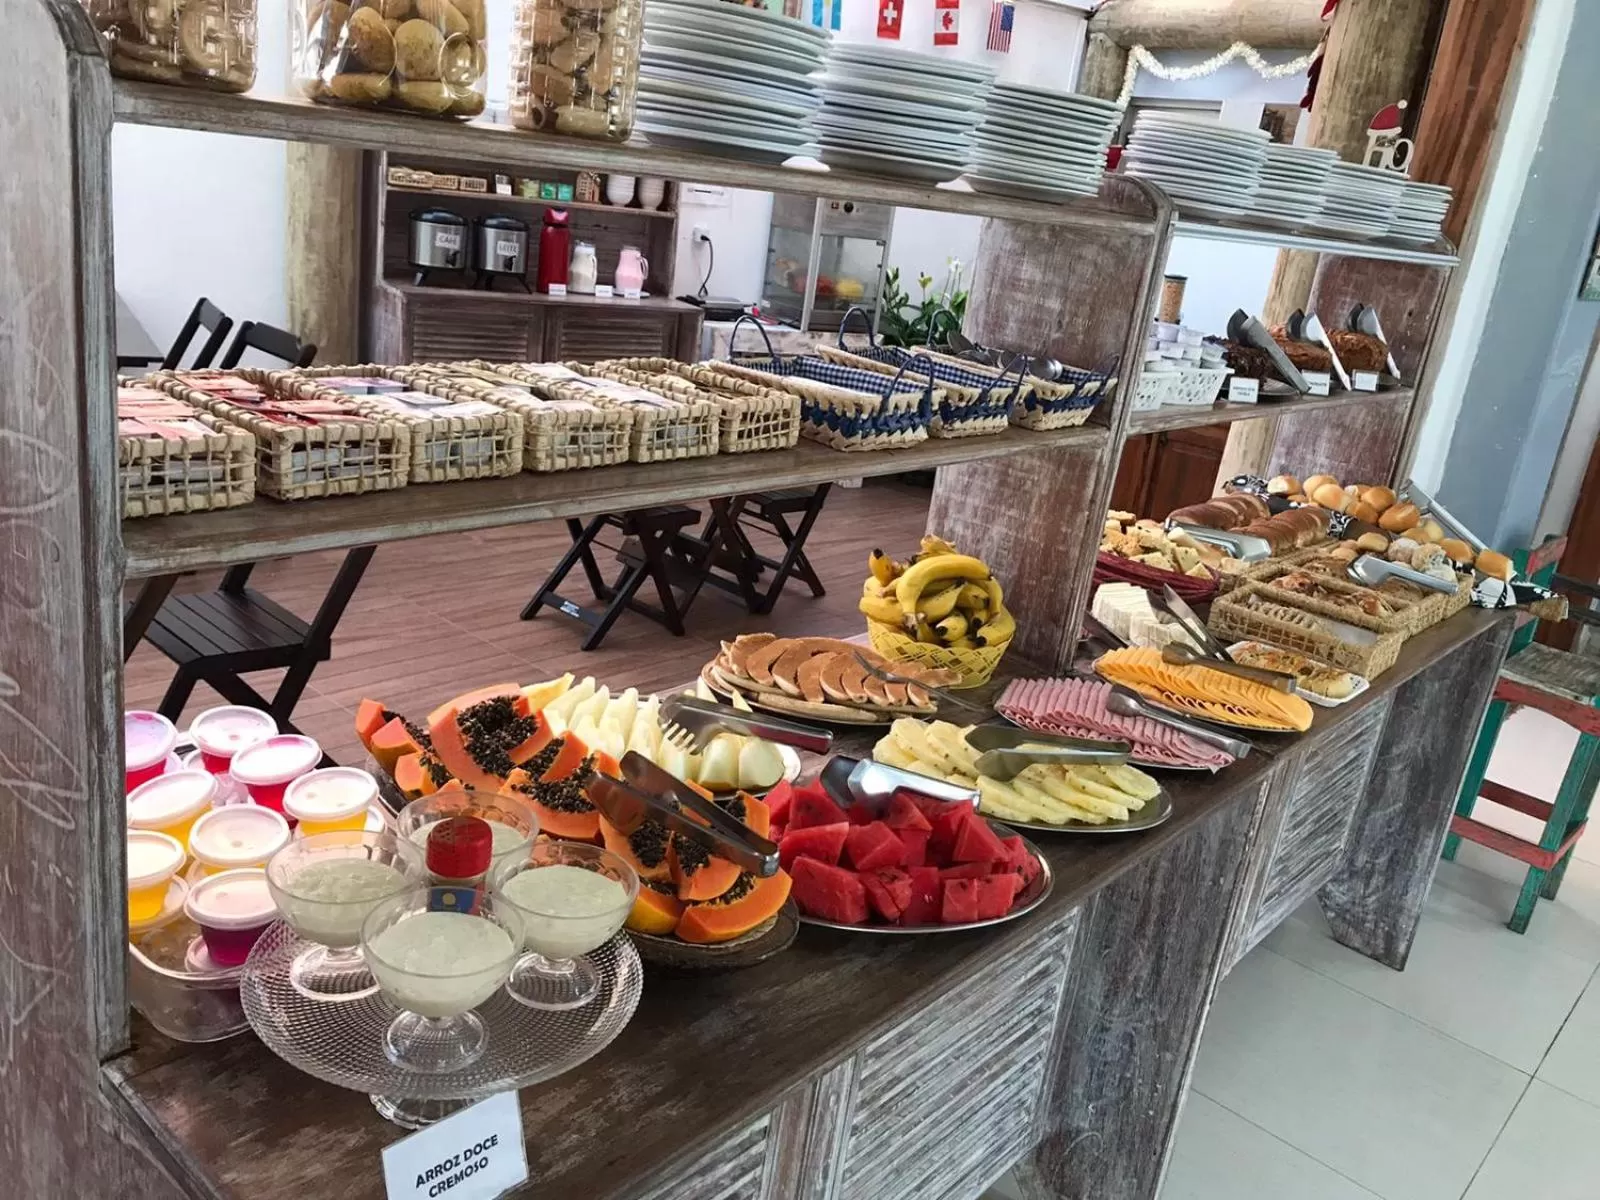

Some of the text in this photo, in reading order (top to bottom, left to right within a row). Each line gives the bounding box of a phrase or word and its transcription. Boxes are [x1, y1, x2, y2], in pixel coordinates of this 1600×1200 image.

[416, 1134, 498, 1188] ARROZ DOCE
[429, 1156, 488, 1198] CREMOSO
